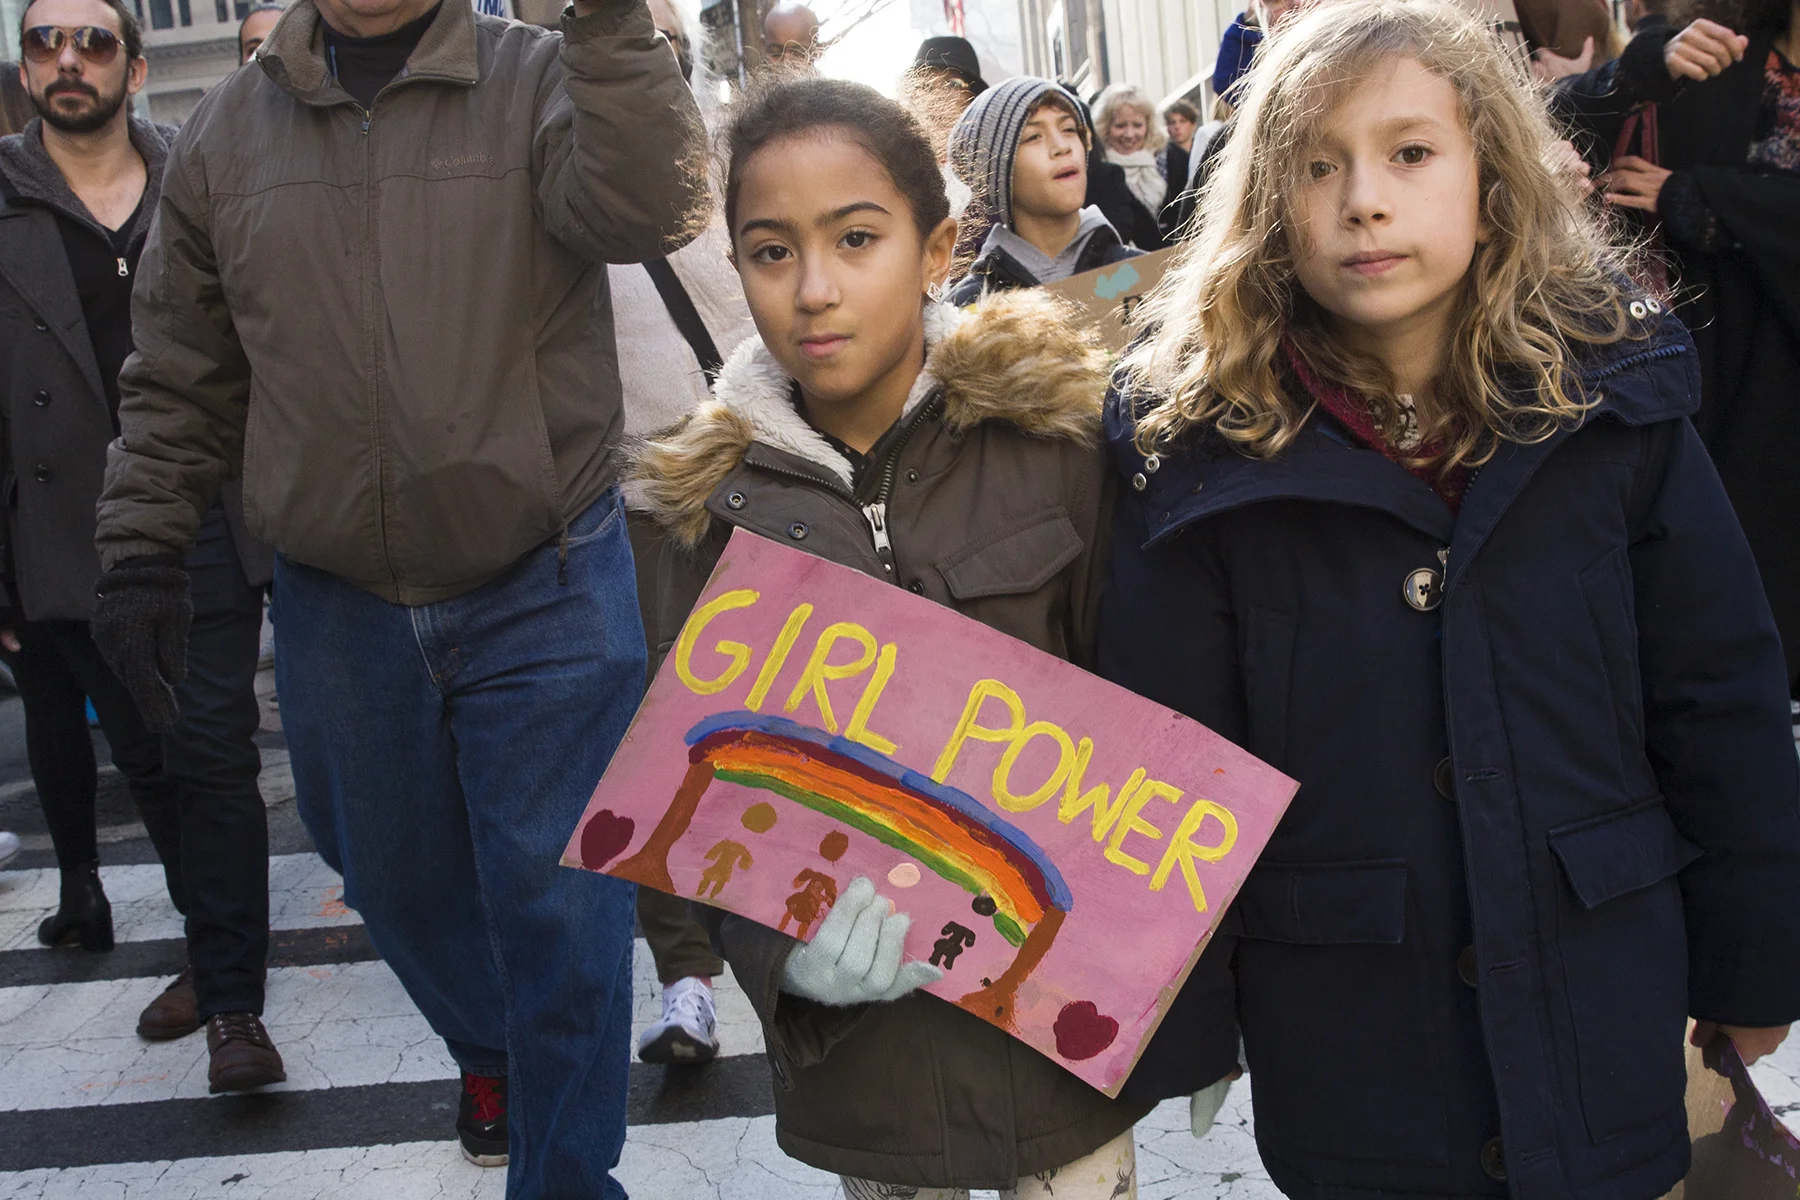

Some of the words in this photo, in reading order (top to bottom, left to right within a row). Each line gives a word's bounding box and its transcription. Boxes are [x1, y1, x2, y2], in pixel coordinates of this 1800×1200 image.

[444, 151, 496, 168] Columba
[674, 588, 901, 755] GIRL
[932, 678, 1239, 912] POWER
